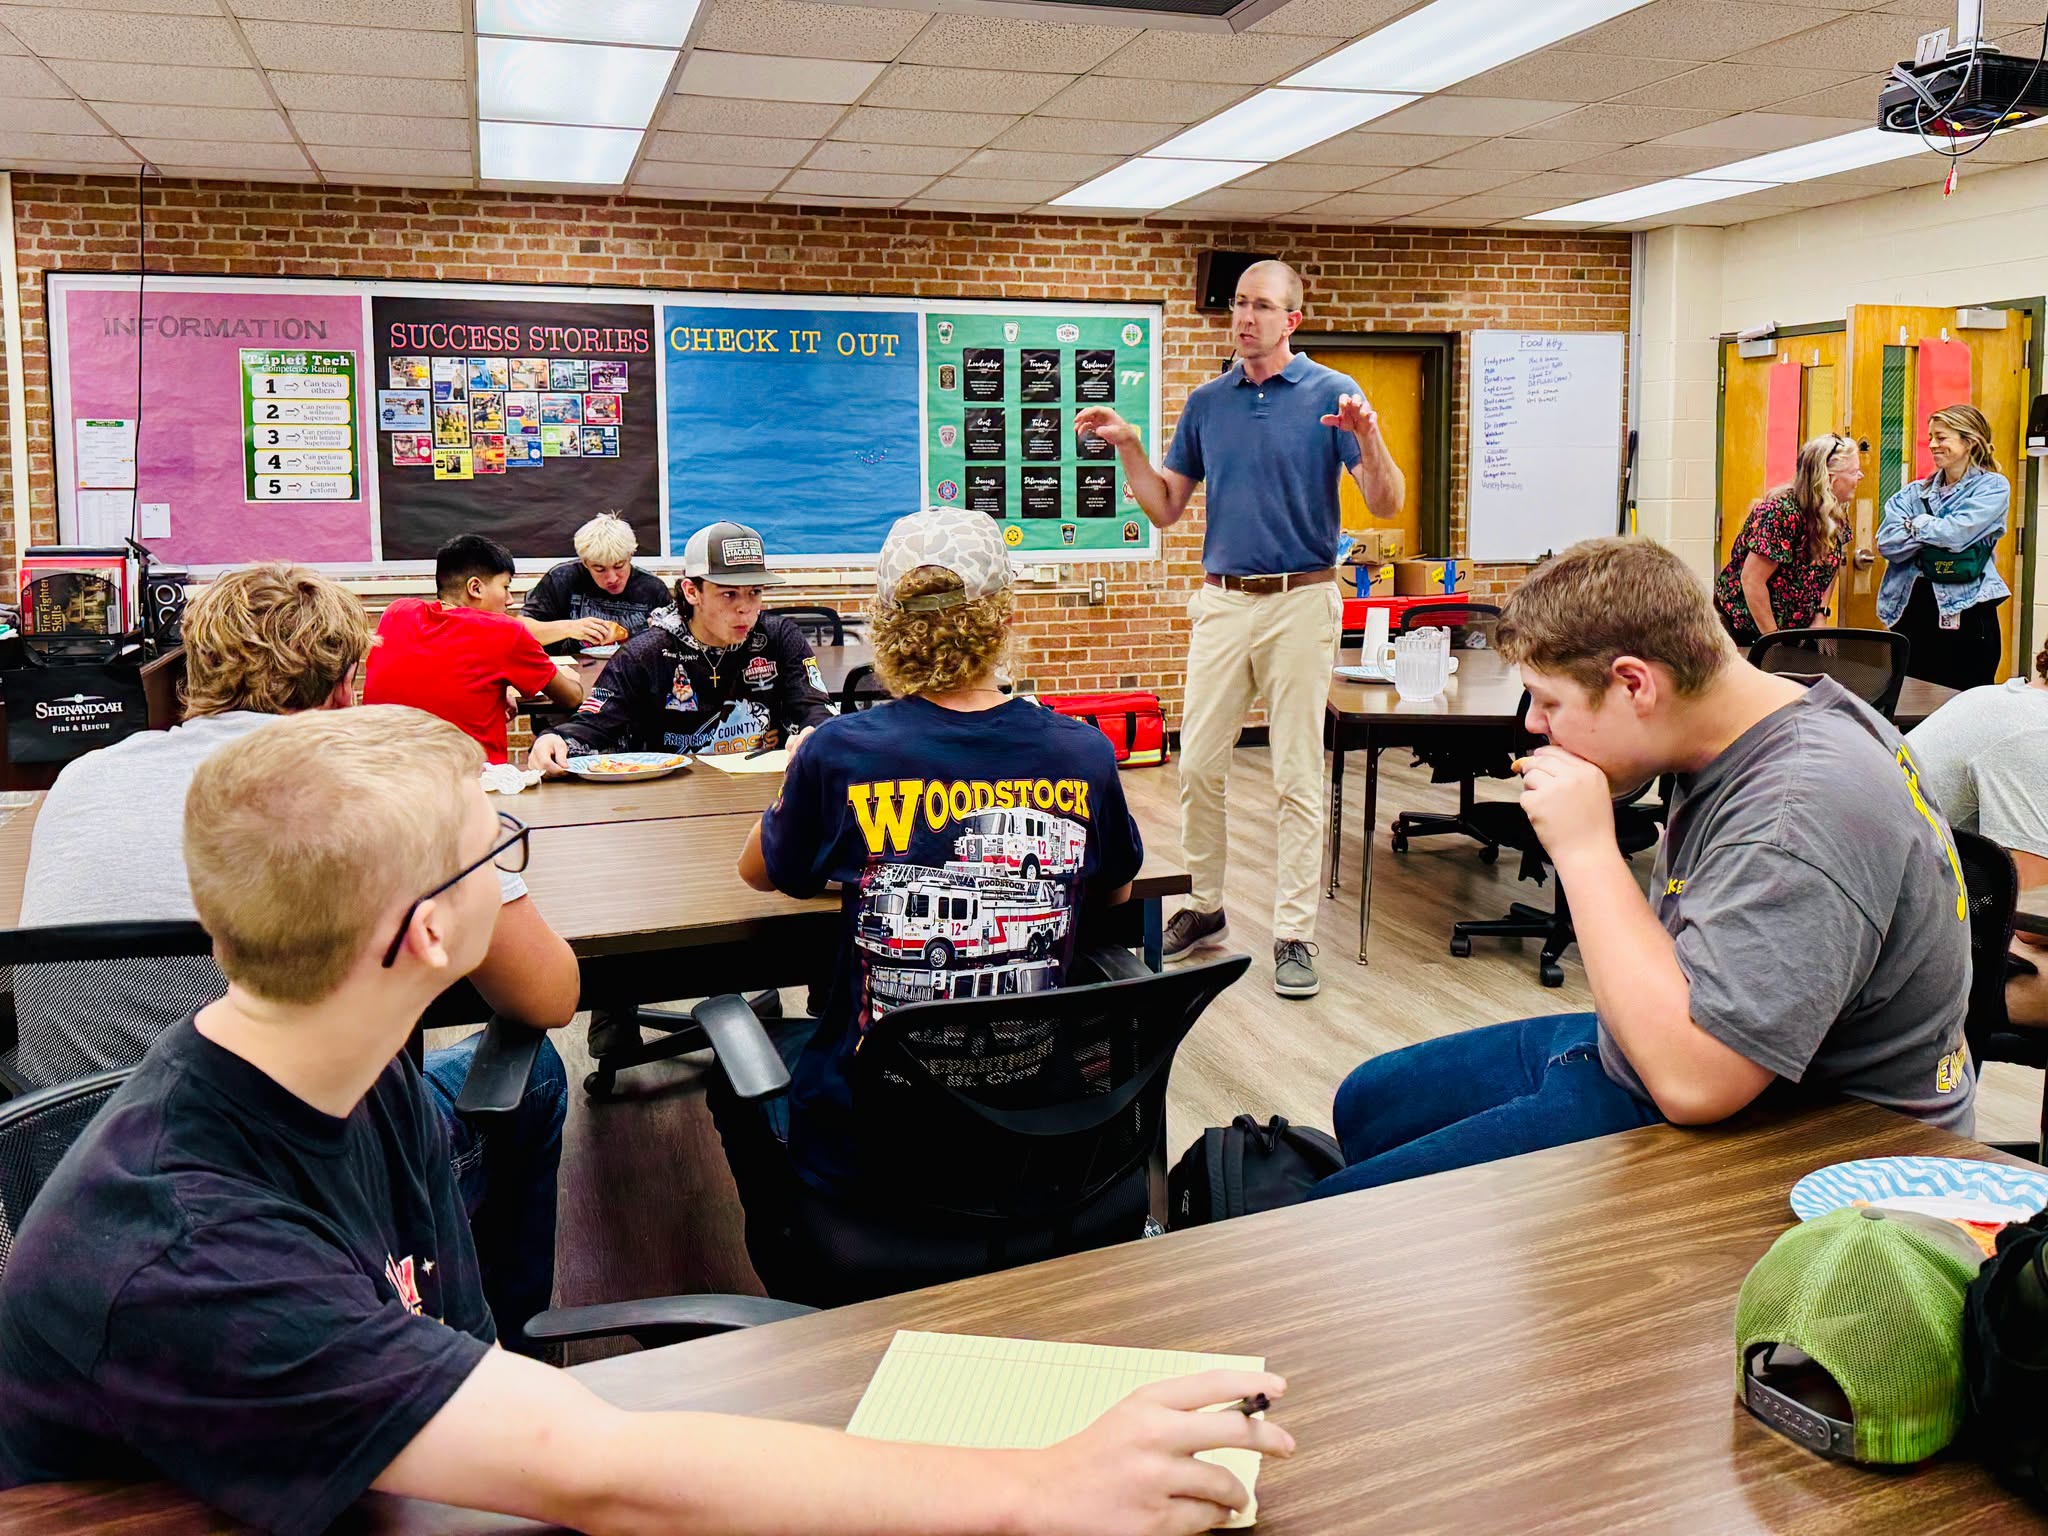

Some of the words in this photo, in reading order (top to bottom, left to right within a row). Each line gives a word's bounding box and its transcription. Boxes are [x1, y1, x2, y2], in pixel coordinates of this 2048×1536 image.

[103, 315, 328, 340] INFORMATION
[390, 322, 521, 351] SUCCESS
[528, 326, 650, 353] STORIES
[670, 326, 779, 352] CHECK
[789, 330, 821, 353] IT
[837, 332, 899, 356] OUT
[1520, 335, 1543, 348] Food
[248, 354, 308, 366] Triplett
[312, 355, 350, 366] Tech
[967, 359, 1000, 370] Leadership
[262, 365, 309, 374] Competency
[311, 366, 337, 374] Rating
[266, 379, 277, 394] 1
[321, 380, 342, 388] teach
[266, 404, 280, 419] 2
[267, 430, 279, 444] 3
[268, 455, 281, 469] 4
[269, 480, 281, 494] 5
[40, 579, 52, 612] Fighter
[41, 613, 51, 632] Fire
[52, 604, 62, 632] Skills
[36, 702, 123, 719] SHENANDOAH
[52, 725, 70, 733] FIRE
[82, 723, 110, 732] RESCUE
[718, 721, 756, 739] COUNTY
[848, 779, 1091, 856] WOODSTOCK
[1038, 840, 1047, 855] 12
[978, 879, 1026, 890] WOODSTOCK
[1663, 879, 1686, 896] KE
[951, 923, 961, 936] 12
